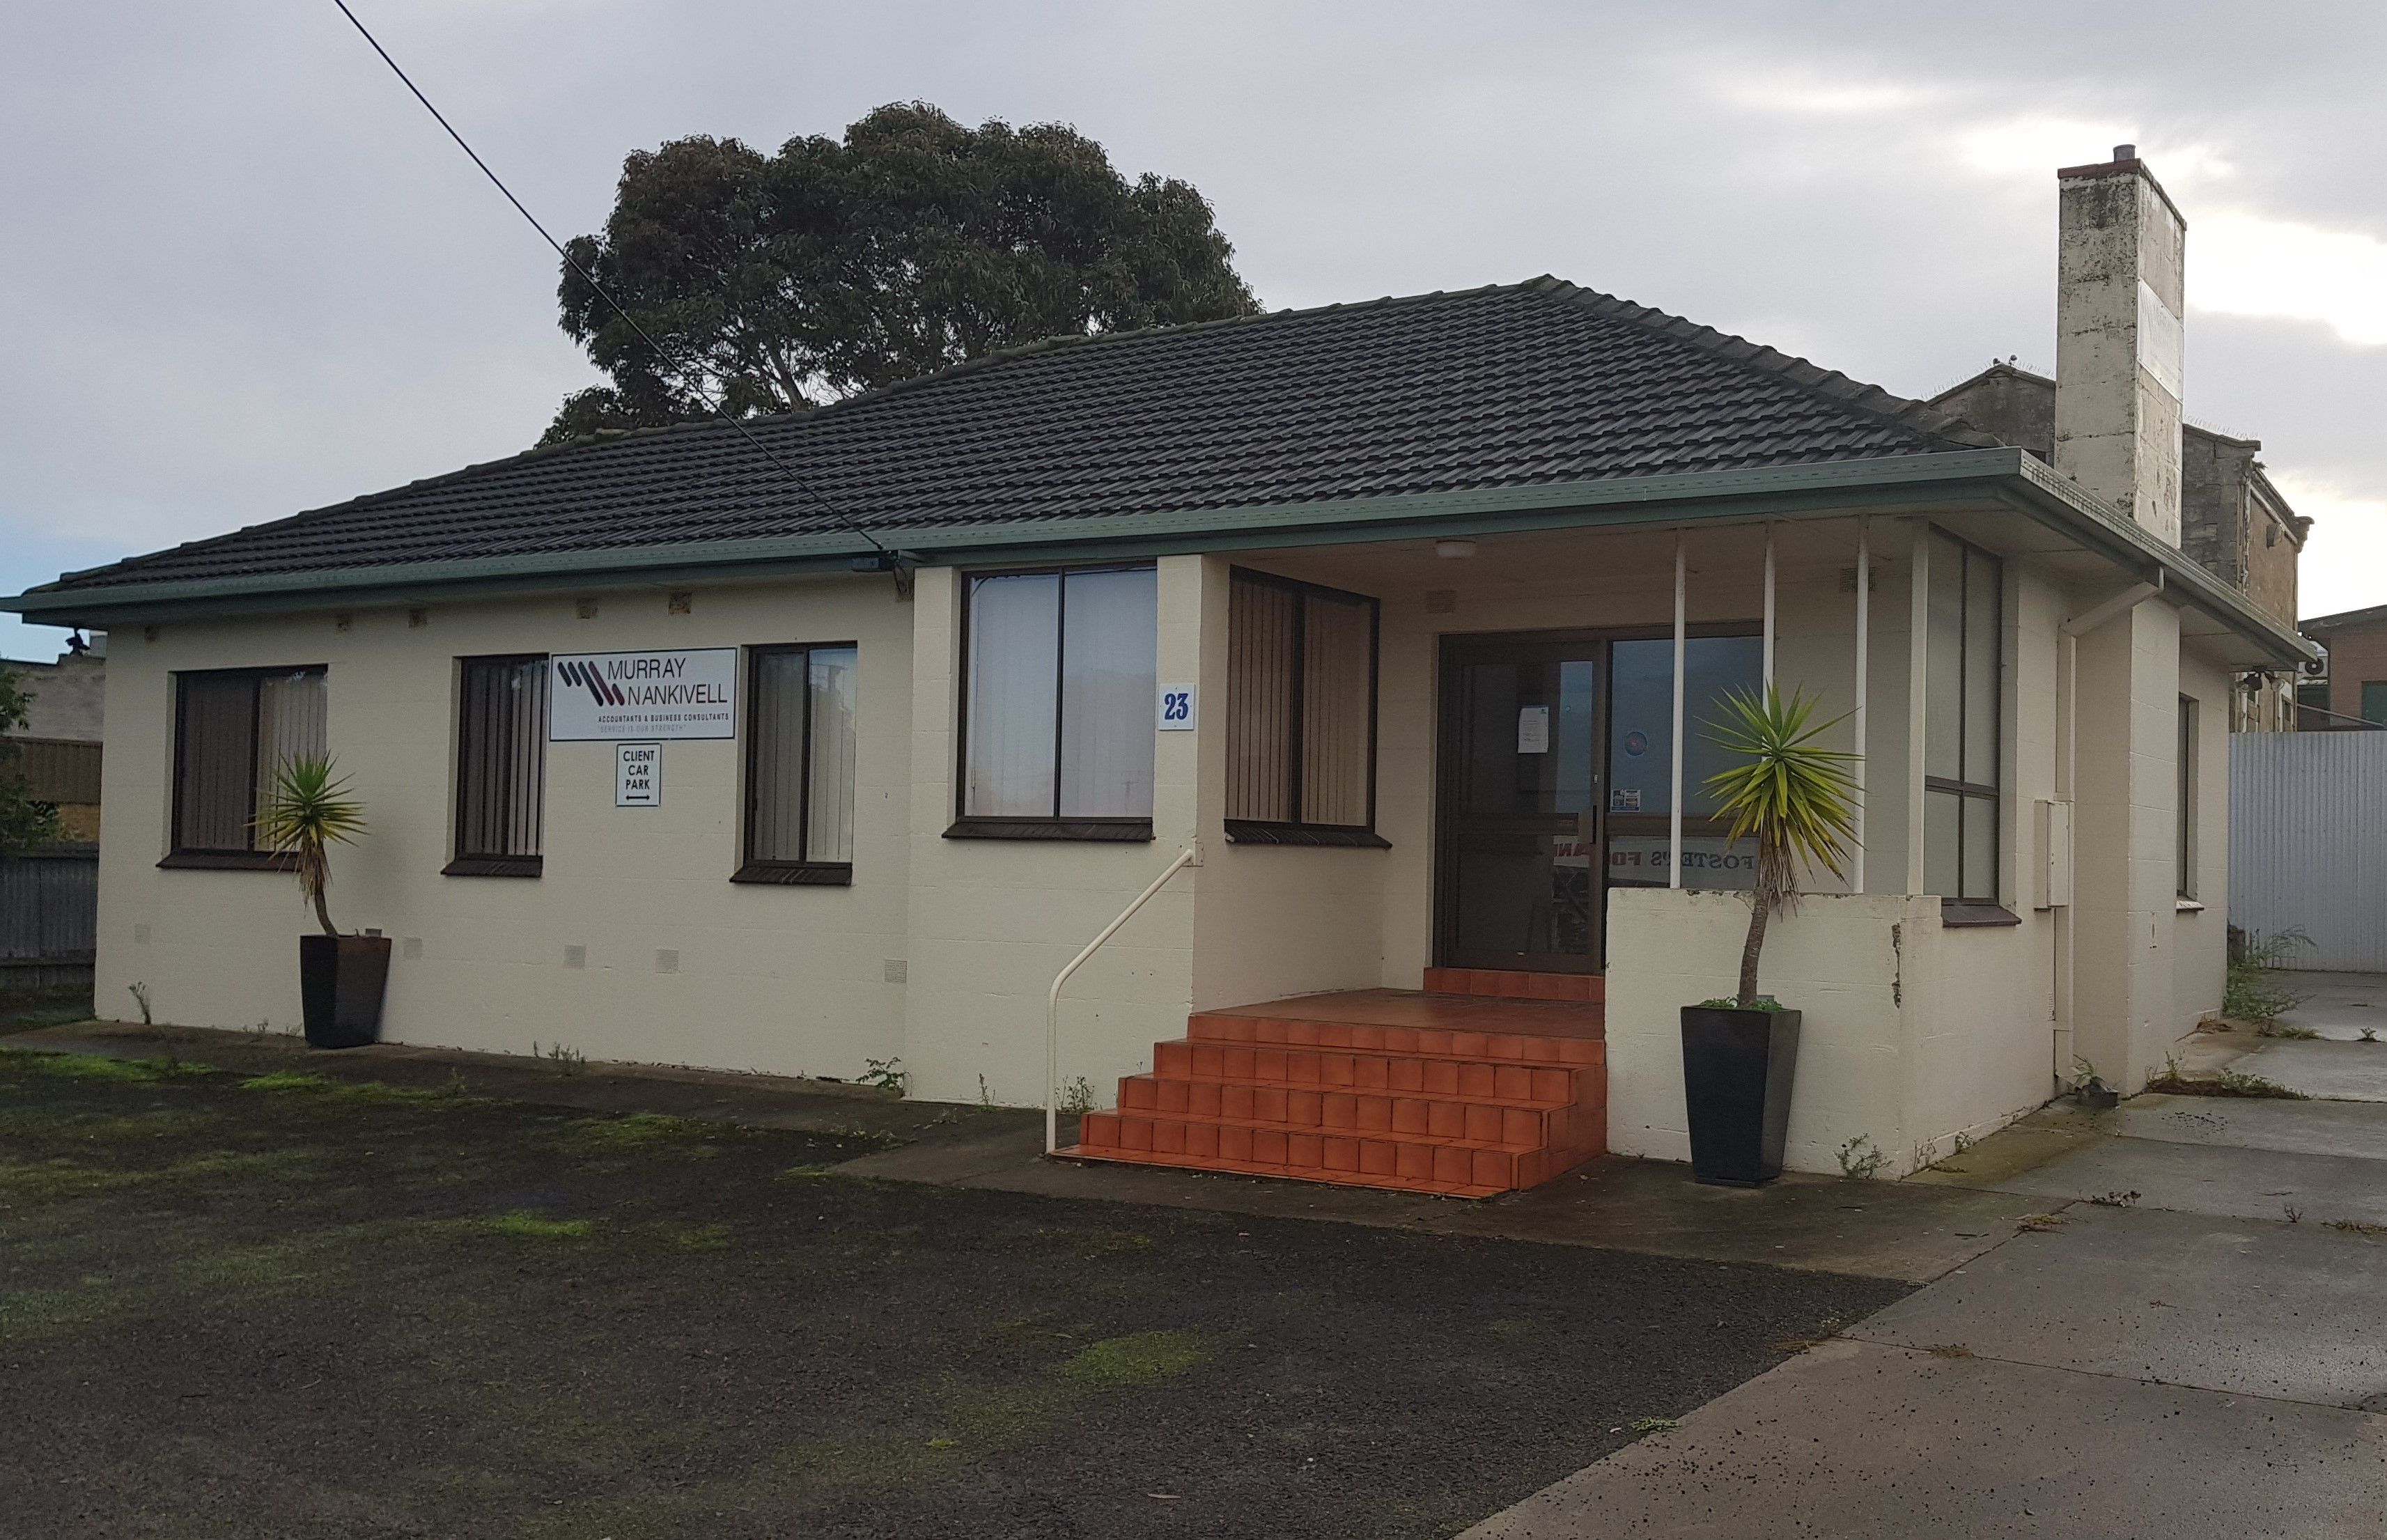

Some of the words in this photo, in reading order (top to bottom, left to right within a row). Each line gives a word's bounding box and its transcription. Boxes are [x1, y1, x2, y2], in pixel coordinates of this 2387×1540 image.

[607, 658, 686, 680] MURRAY
[628, 683, 728, 706] NANKIVELL
[1164, 692, 1189, 720] 23
[598, 715, 642, 723] ACCOUNTANTS
[651, 714, 681, 722] BUSINESS
[683, 713, 729, 722] CONSULTANTS
[623, 750, 655, 762] CLIENT
[628, 765, 648, 776] CAR
[625, 779, 650, 791] PARK
